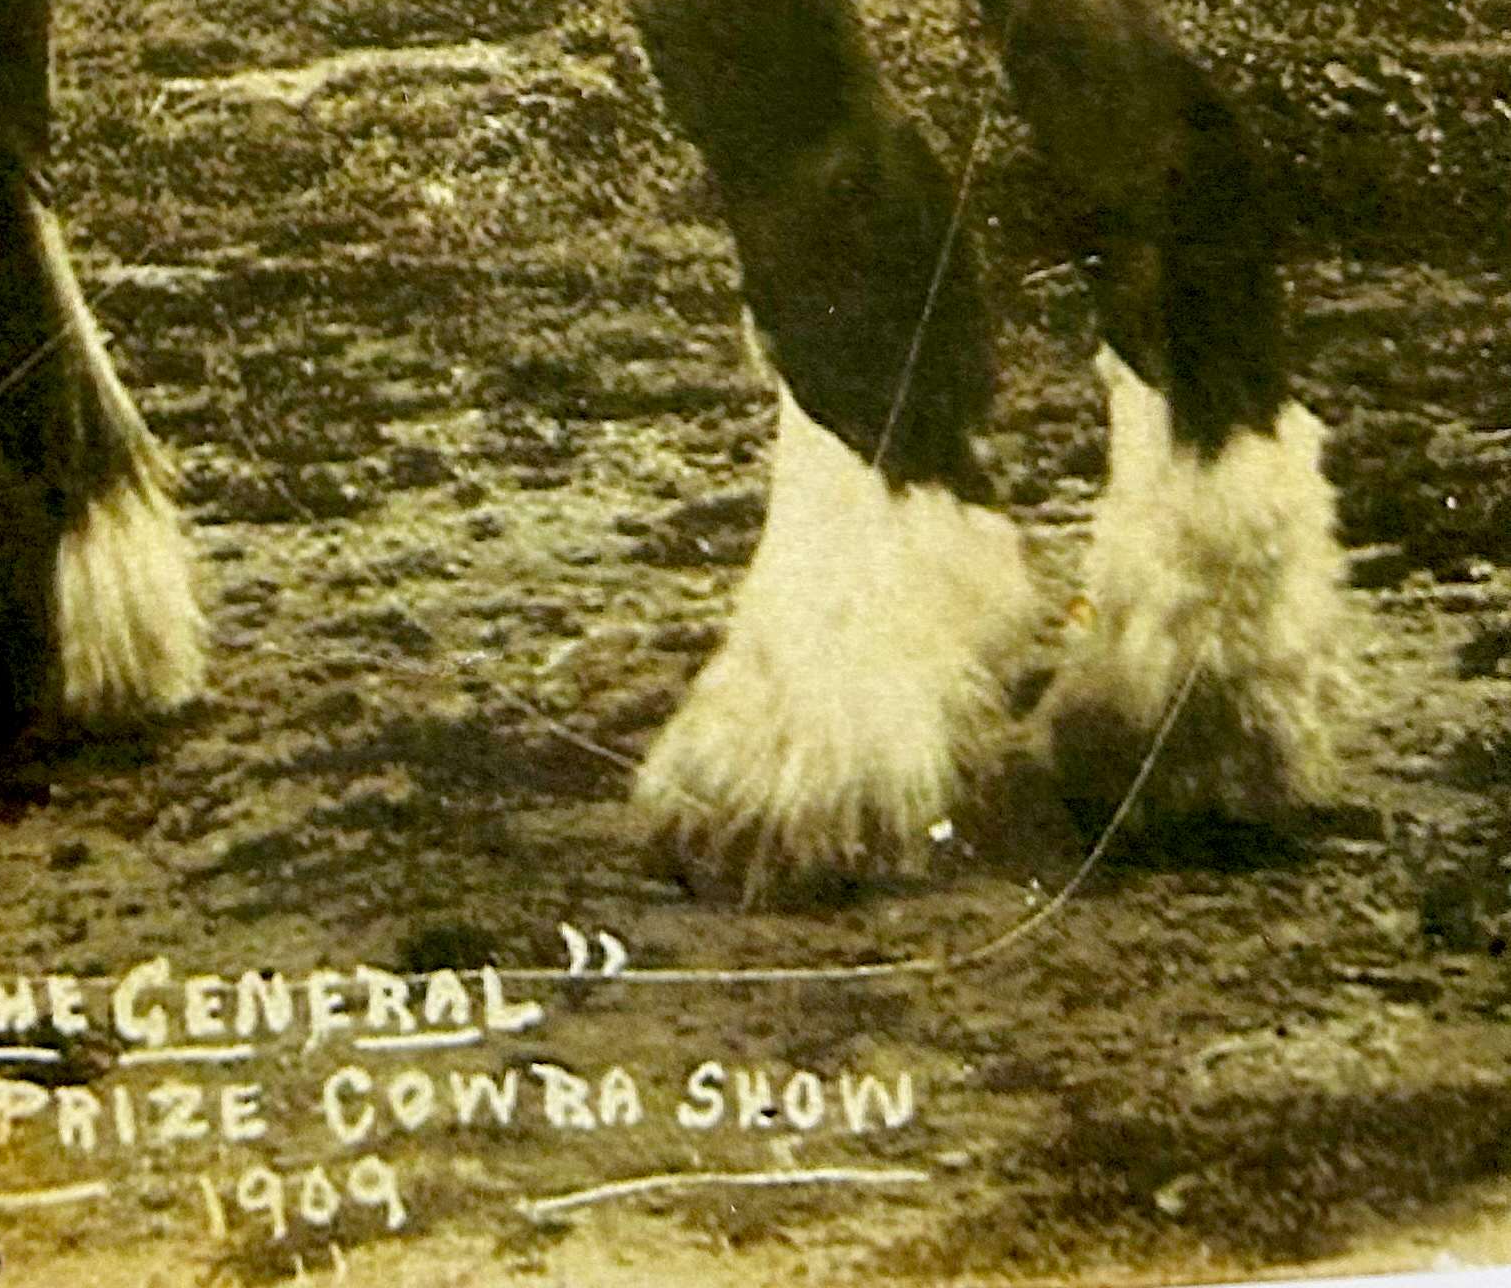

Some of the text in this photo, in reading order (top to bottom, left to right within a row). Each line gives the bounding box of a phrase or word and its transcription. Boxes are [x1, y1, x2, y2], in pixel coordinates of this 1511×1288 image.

[323, 1062, 641, 1144] COWRA
[677, 1060, 913, 1132] SHOW
[200, 1155, 407, 1240] 1909
